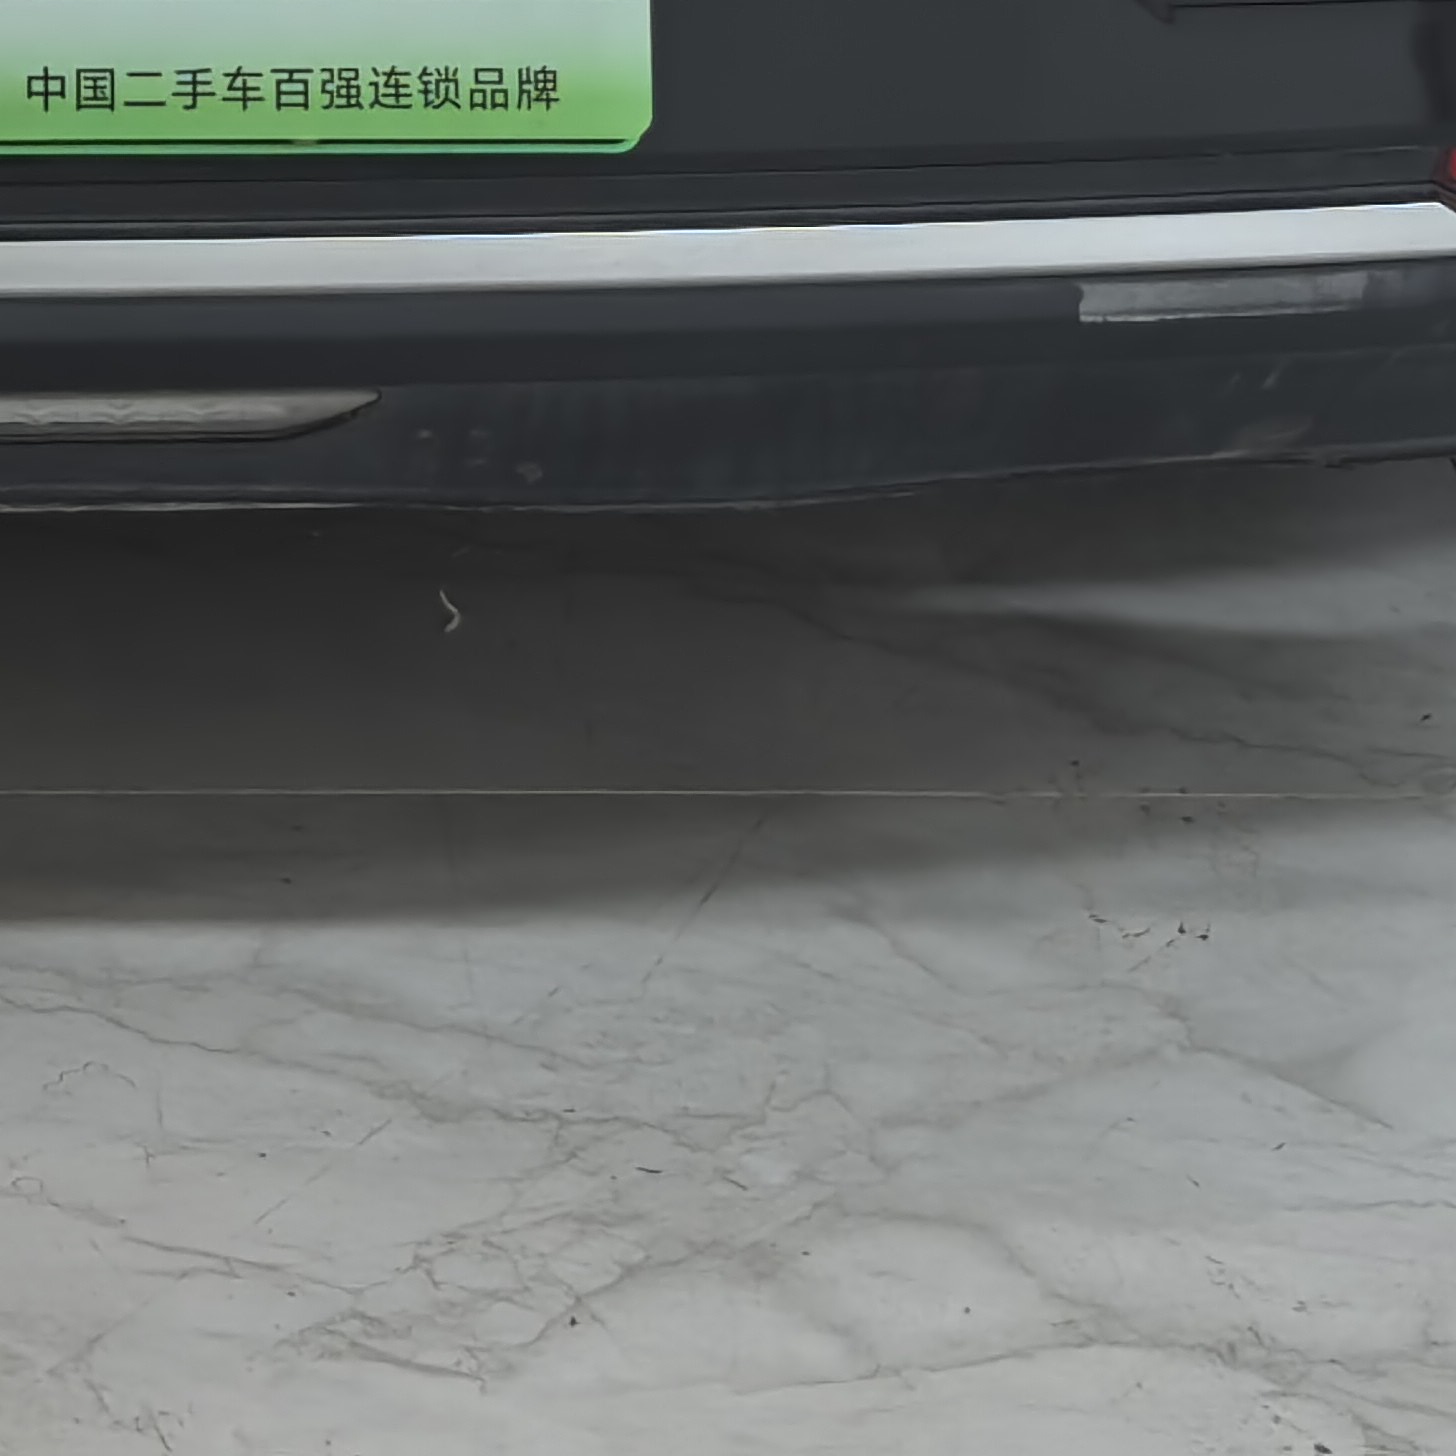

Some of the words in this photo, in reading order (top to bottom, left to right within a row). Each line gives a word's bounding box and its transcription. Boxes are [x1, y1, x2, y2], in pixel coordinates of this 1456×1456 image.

[25, 64, 561, 113] 中国二手车百强连锁品牌
